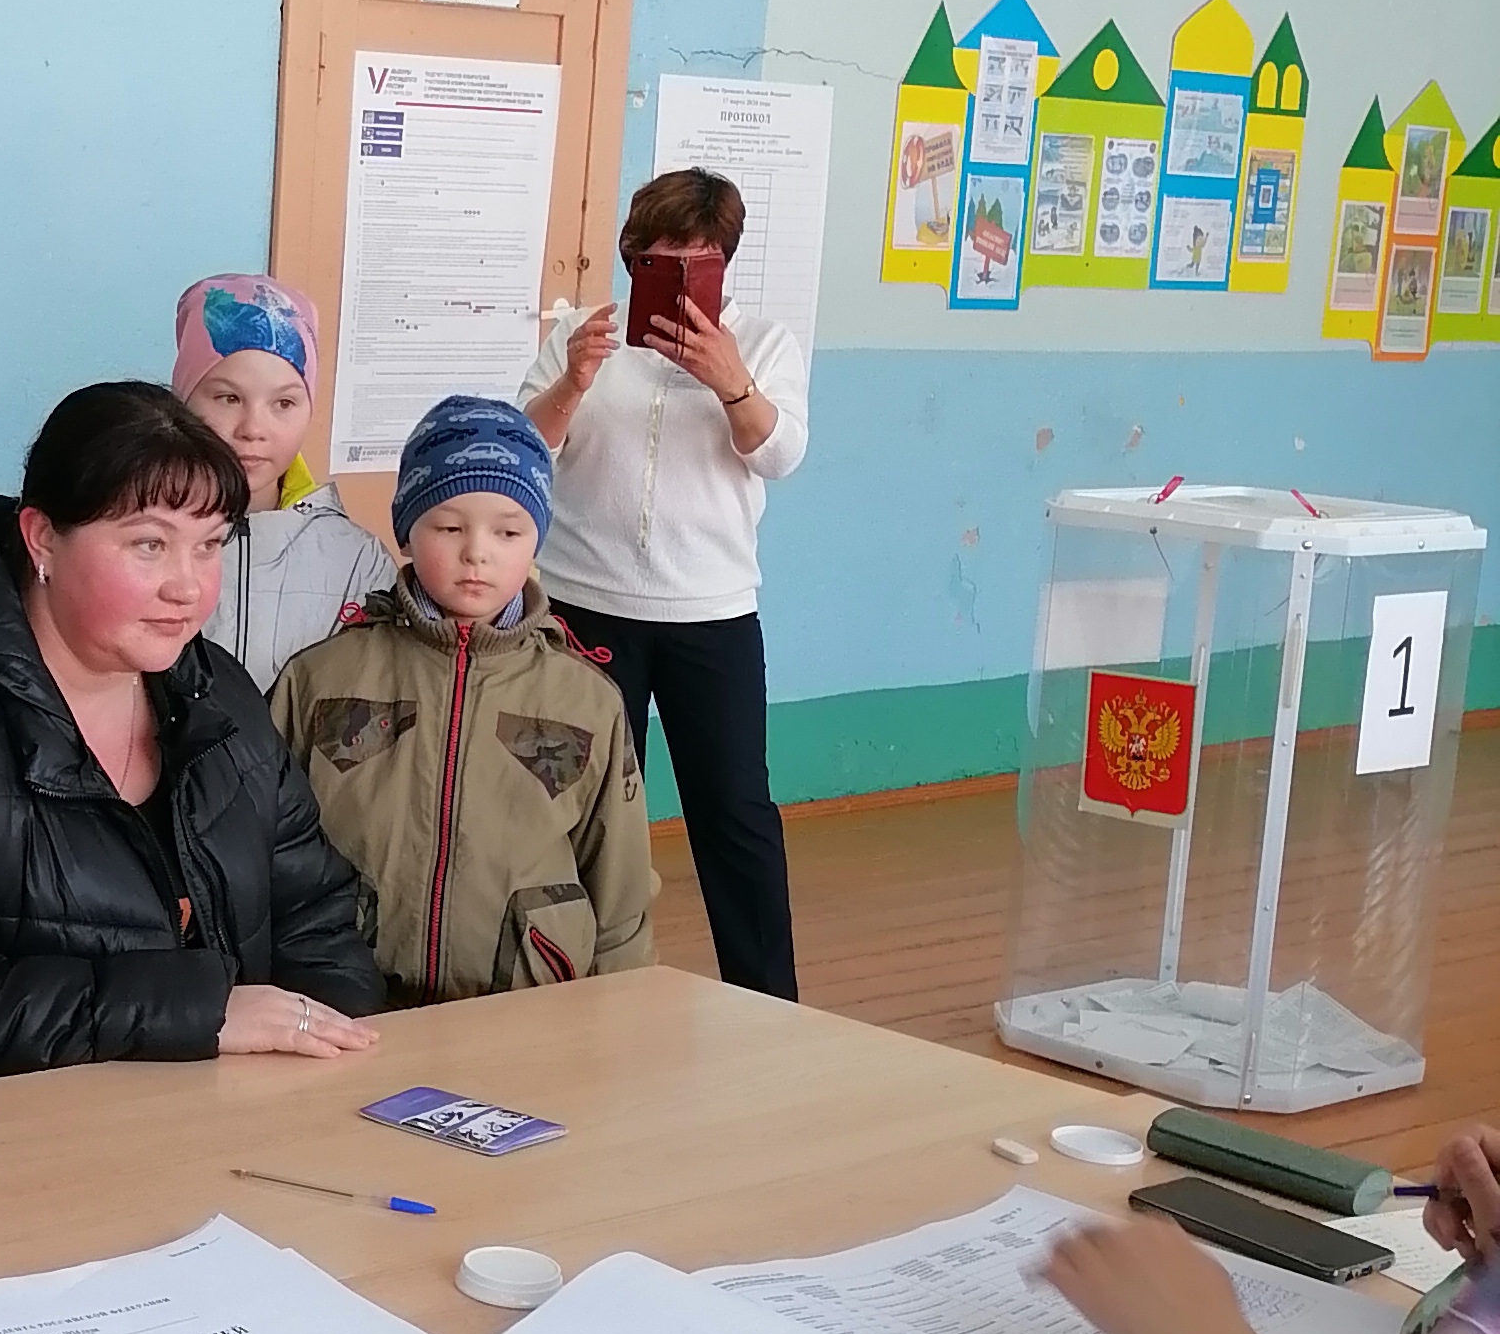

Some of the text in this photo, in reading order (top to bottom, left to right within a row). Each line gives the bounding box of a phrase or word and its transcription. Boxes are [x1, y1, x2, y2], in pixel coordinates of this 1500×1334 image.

[720, 111, 771, 124] ПРОТОКОЛ
[1387, 635, 1417, 718] 1
[37, 1311, 108, 1329] РОССИЙСКОЙ
[110, 1297, 171, 1314] ФЕДЕРАЦИИ
